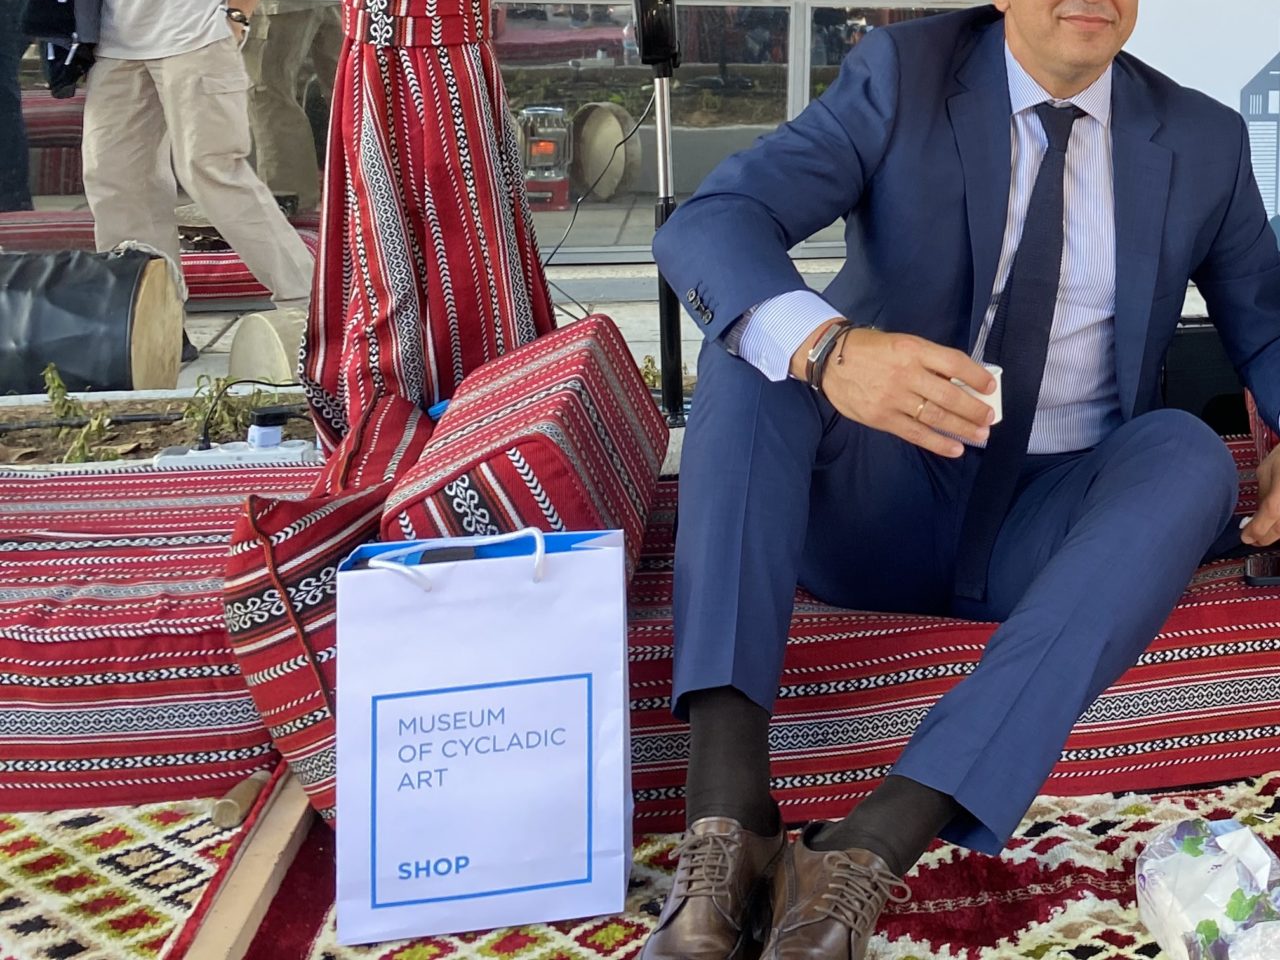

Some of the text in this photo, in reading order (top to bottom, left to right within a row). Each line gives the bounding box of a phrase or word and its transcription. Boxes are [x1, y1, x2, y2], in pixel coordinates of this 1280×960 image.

[398, 707, 505, 736] MUSEUM
[398, 728, 567, 763] OF CYCLADIC
[397, 768, 448, 792] ART
[398, 856, 470, 880] SHOP
